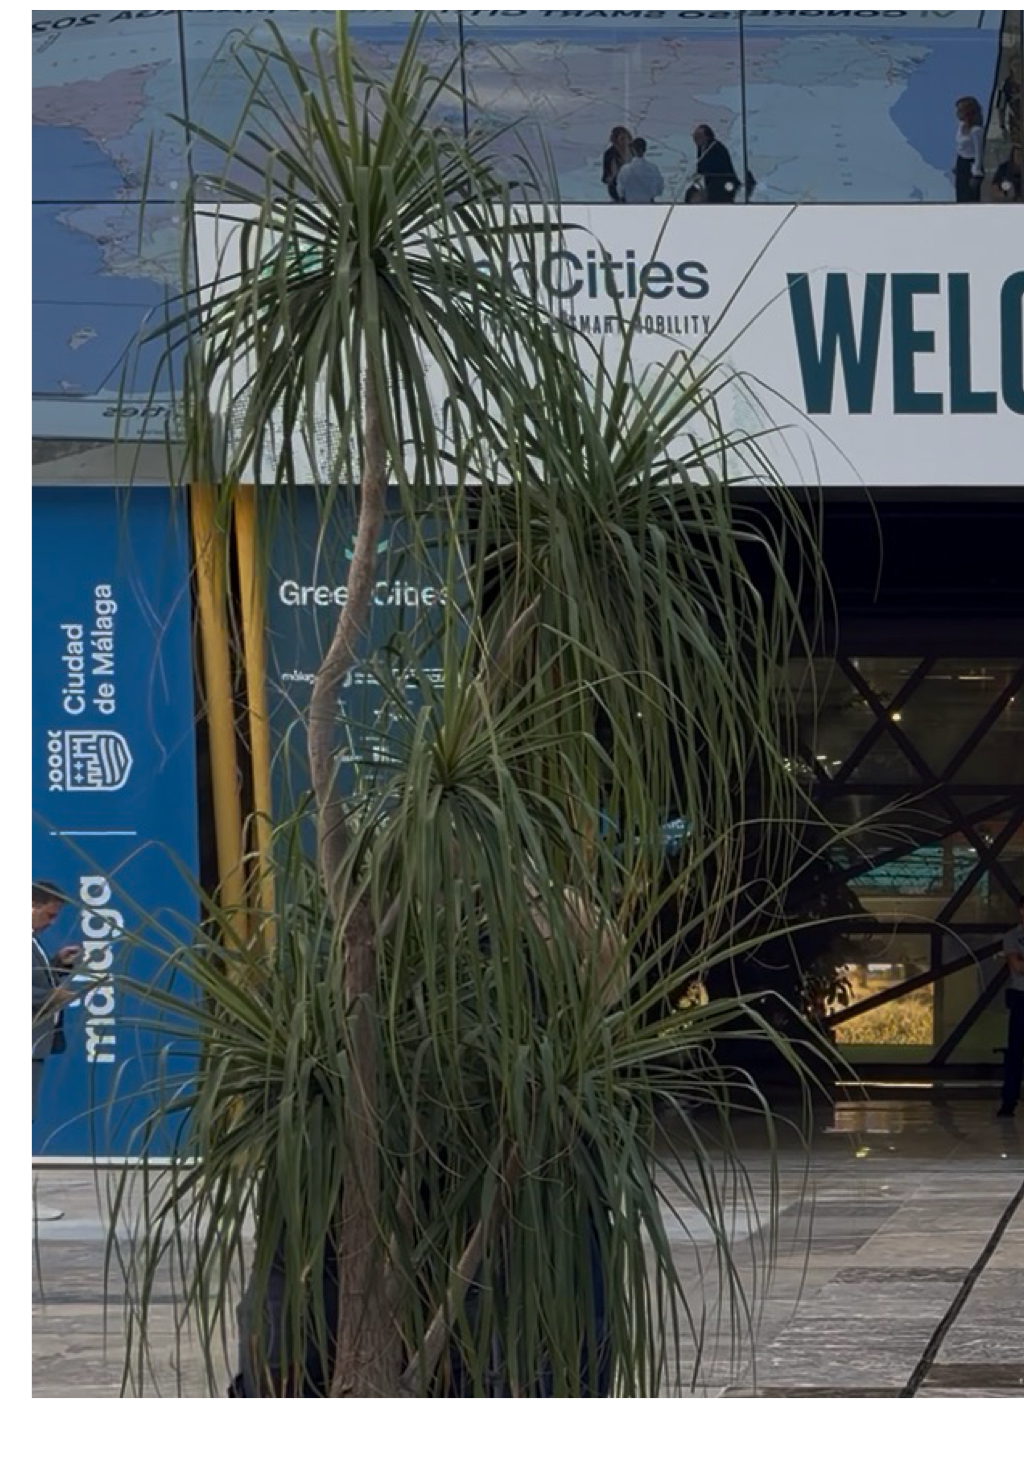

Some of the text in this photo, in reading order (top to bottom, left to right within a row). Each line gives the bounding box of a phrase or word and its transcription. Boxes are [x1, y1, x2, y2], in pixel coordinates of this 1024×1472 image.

[60, 624, 86, 715] Ciudad
[90, 584, 118, 715] de Málaga
[69, 875, 124, 1063] málaga
